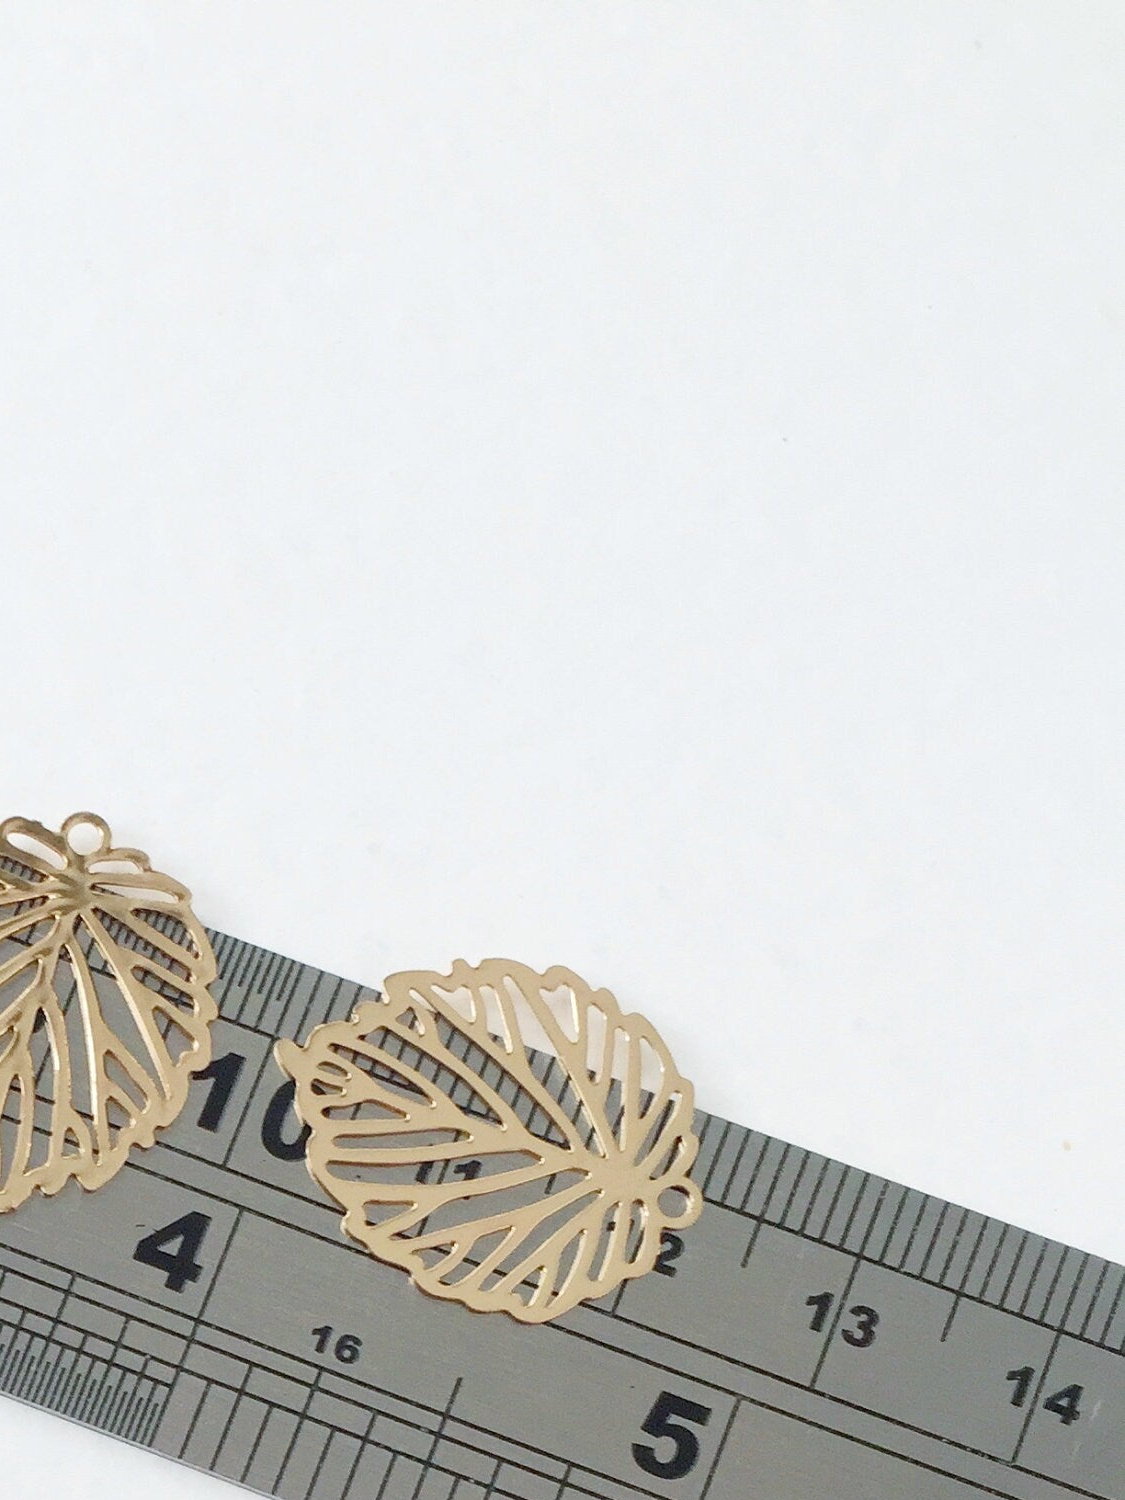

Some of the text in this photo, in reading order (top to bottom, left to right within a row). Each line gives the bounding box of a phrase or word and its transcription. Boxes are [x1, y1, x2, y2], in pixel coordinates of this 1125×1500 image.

[132, 1210, 213, 1294] 4
[631, 1390, 713, 1481] 5
[311, 1325, 363, 1365] 16
[804, 1291, 880, 1348] 13
[1005, 1365, 1084, 1426] 14
